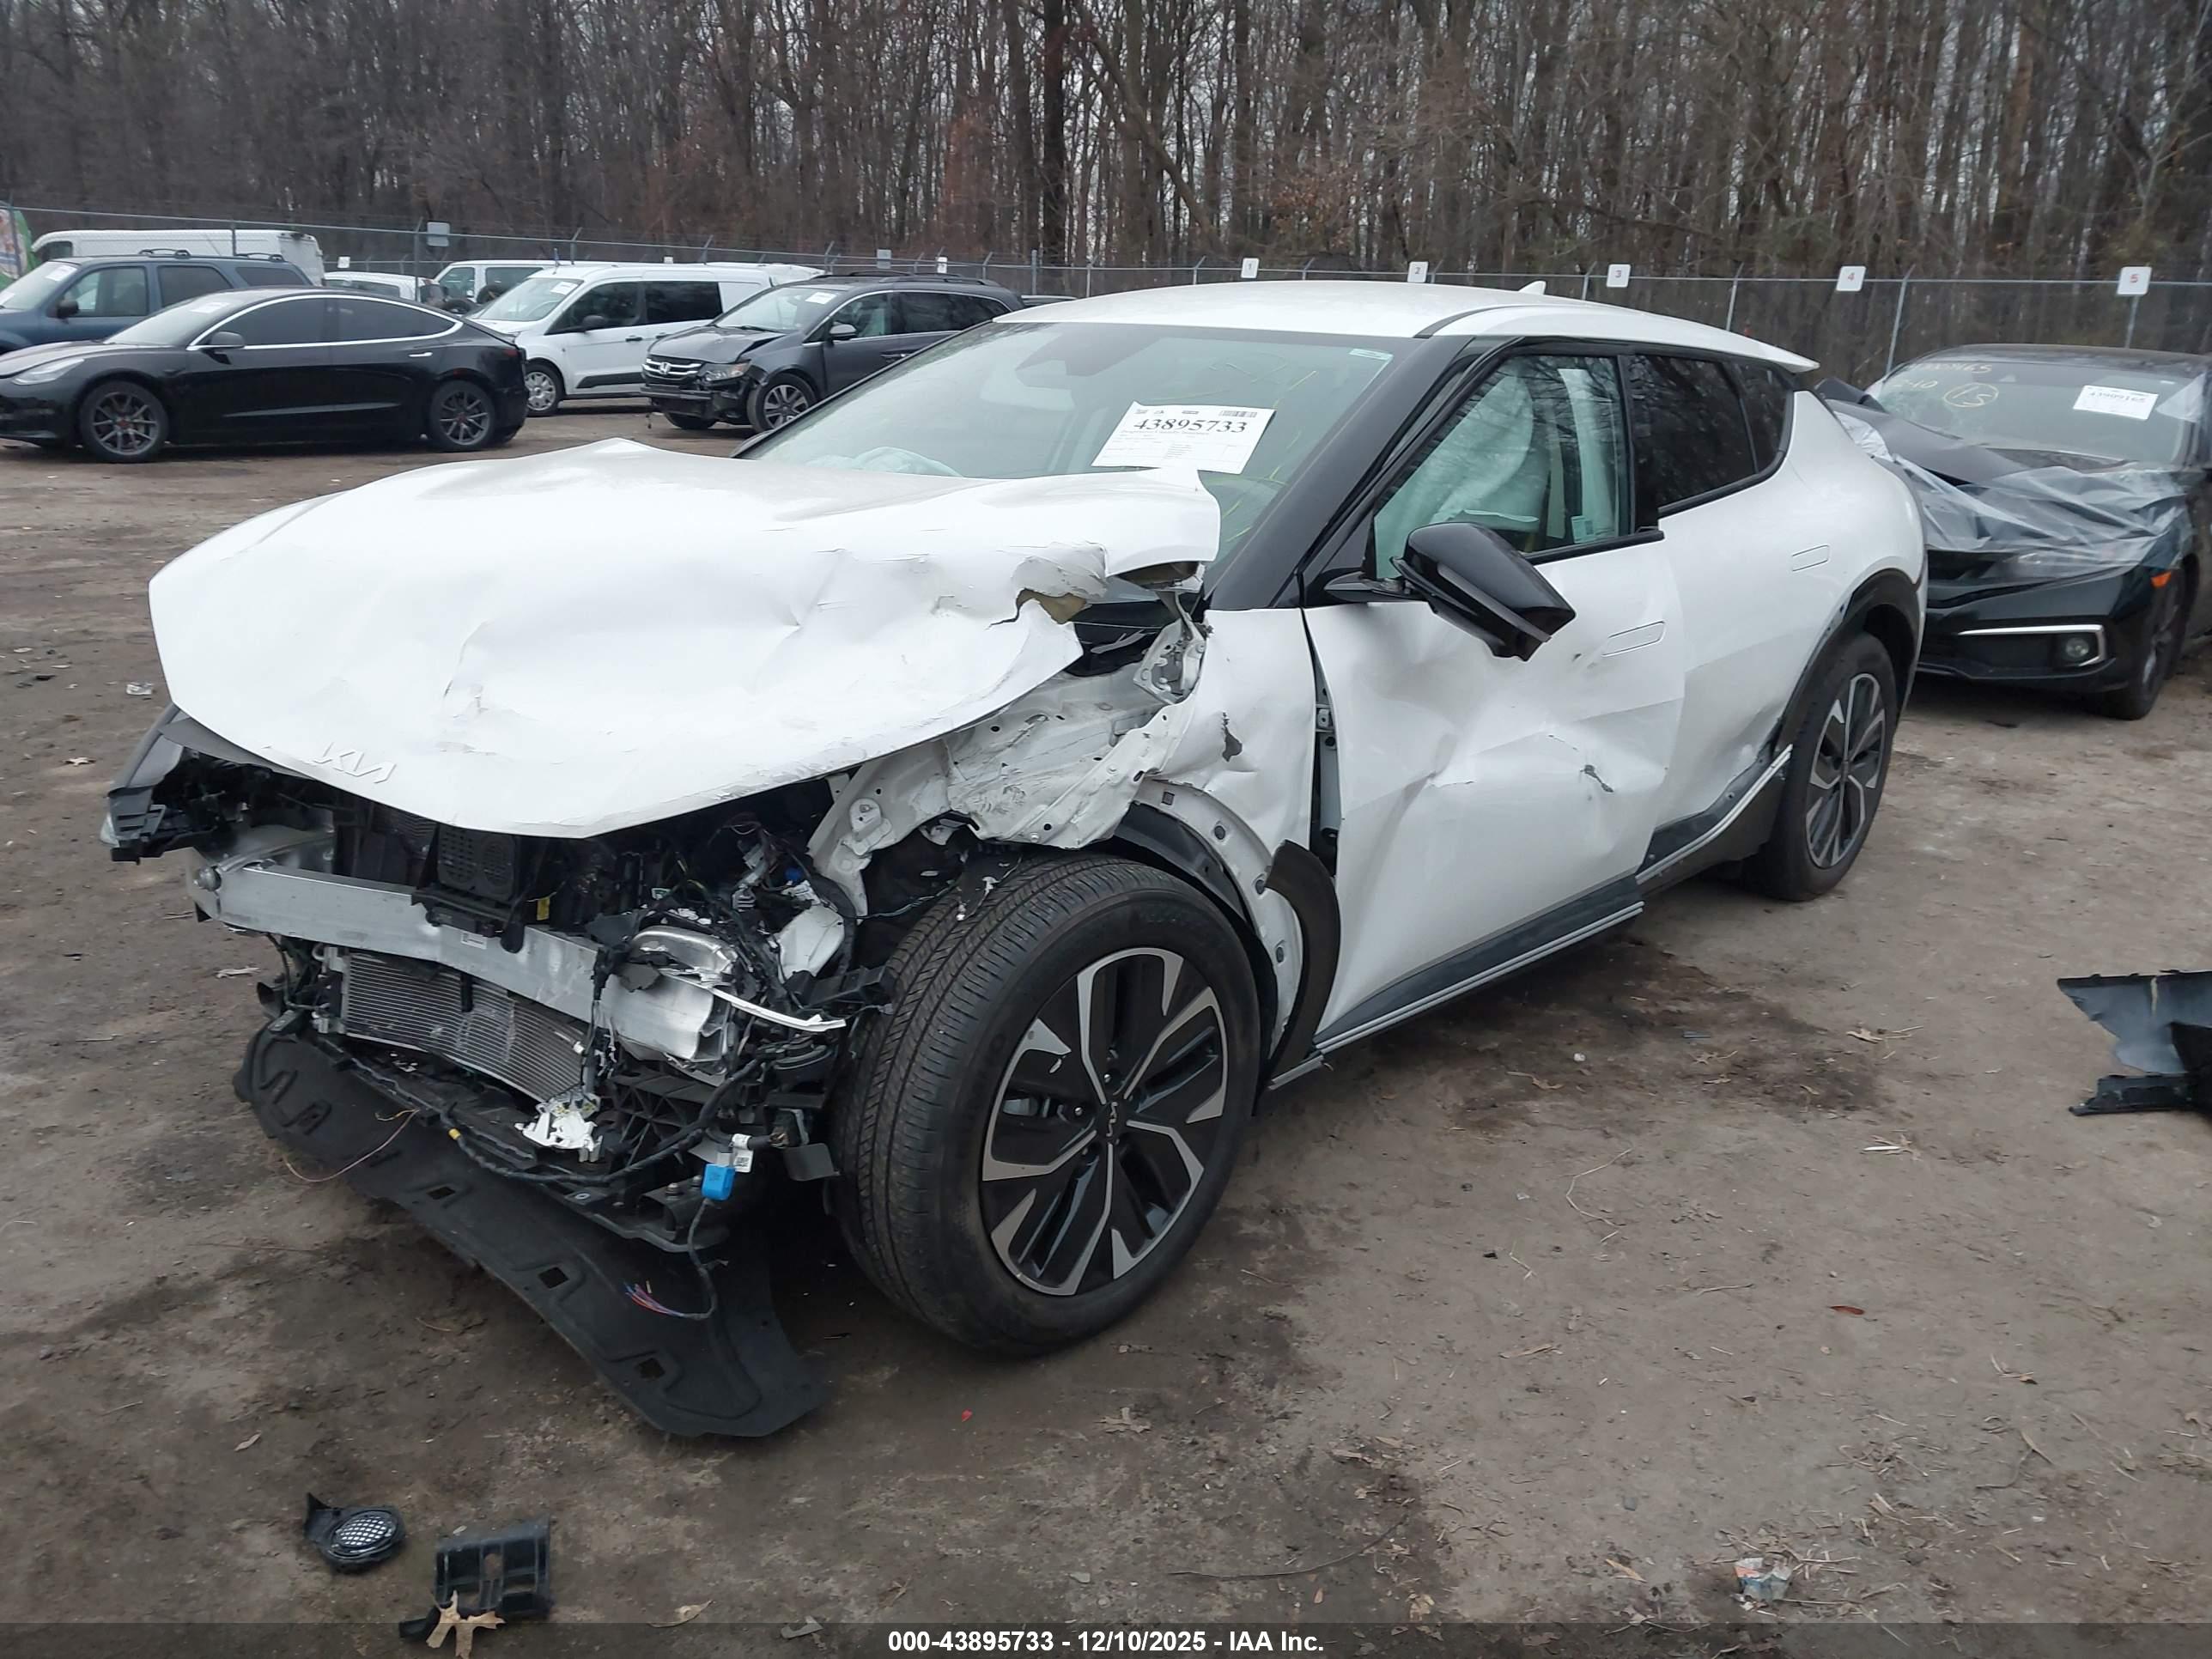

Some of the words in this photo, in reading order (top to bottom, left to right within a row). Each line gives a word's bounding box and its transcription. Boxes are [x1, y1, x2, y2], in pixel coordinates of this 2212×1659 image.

[1415, 266, 1422, 275] 2
[1614, 270, 1622, 278] 3
[2130, 274, 2139, 283] 5
[1133, 418, 1248, 433] 43895733
